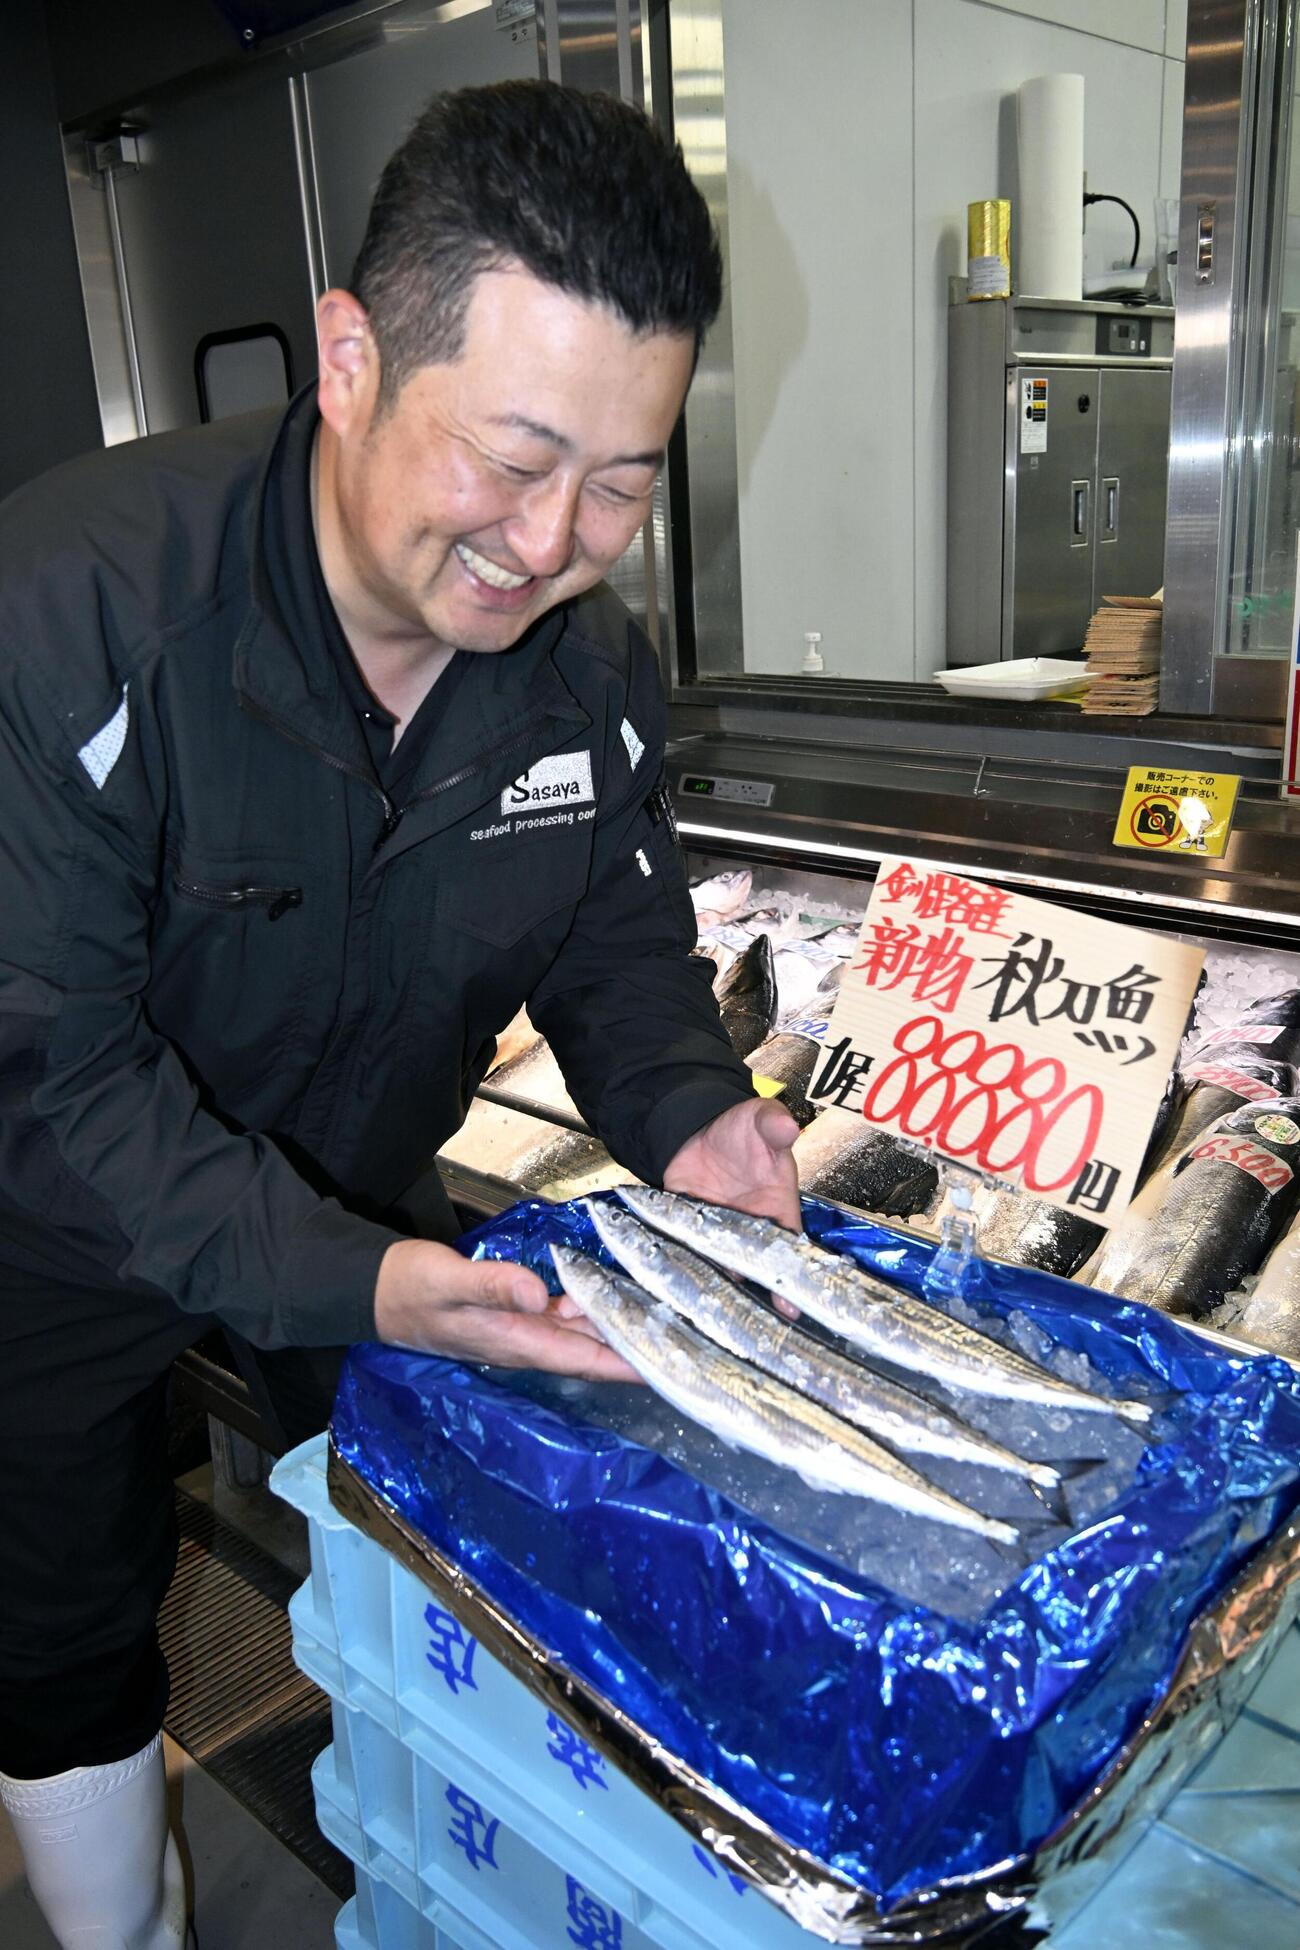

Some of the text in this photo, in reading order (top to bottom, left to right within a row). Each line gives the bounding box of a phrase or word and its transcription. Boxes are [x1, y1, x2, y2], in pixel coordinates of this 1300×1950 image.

[511, 770, 580, 803] Sasaya
[1146, 771, 1215, 786] 販売コーナーでの
[470, 821, 511, 841] seafood
[515, 811, 574, 834] processing
[876, 862, 1014, 939] 釧路産
[852, 916, 1157, 1066] 新物 秋刀魚
